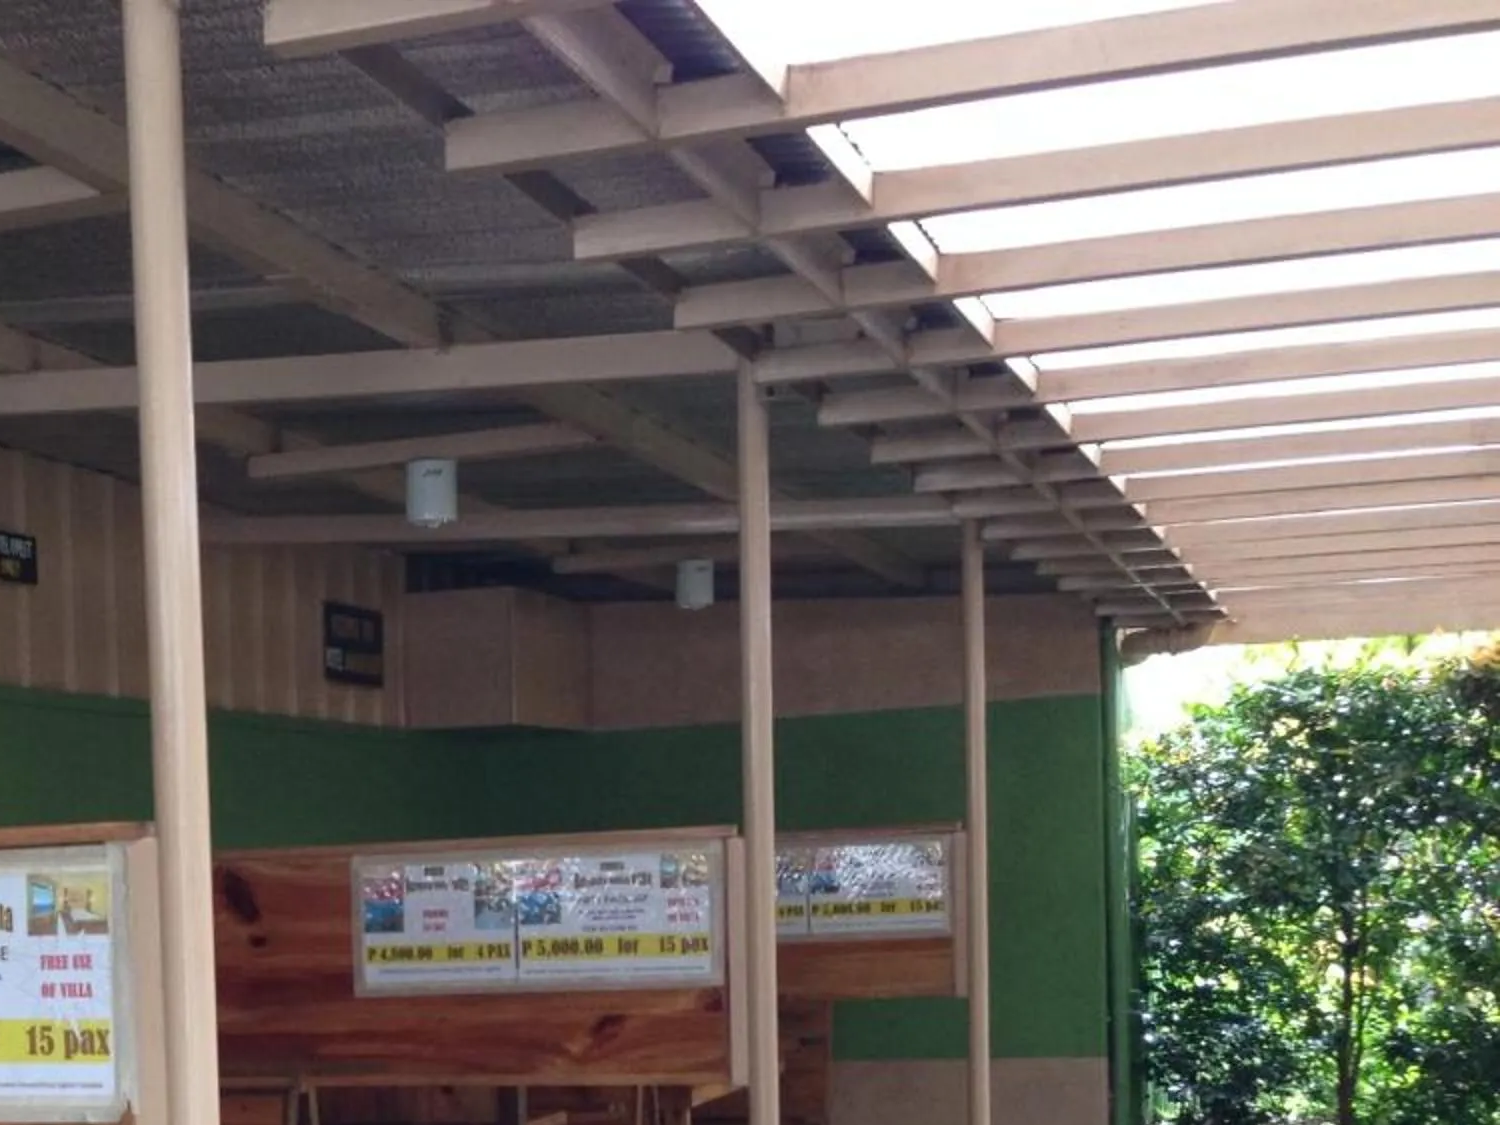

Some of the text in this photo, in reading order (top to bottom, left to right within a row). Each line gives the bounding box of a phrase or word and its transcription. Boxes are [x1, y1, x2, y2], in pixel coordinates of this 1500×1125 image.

[40, 954, 68, 970] FREE
[60, 982, 93, 999] VILLA
[26, 1025, 54, 1055] 15
[64, 1028, 111, 1060] pax
